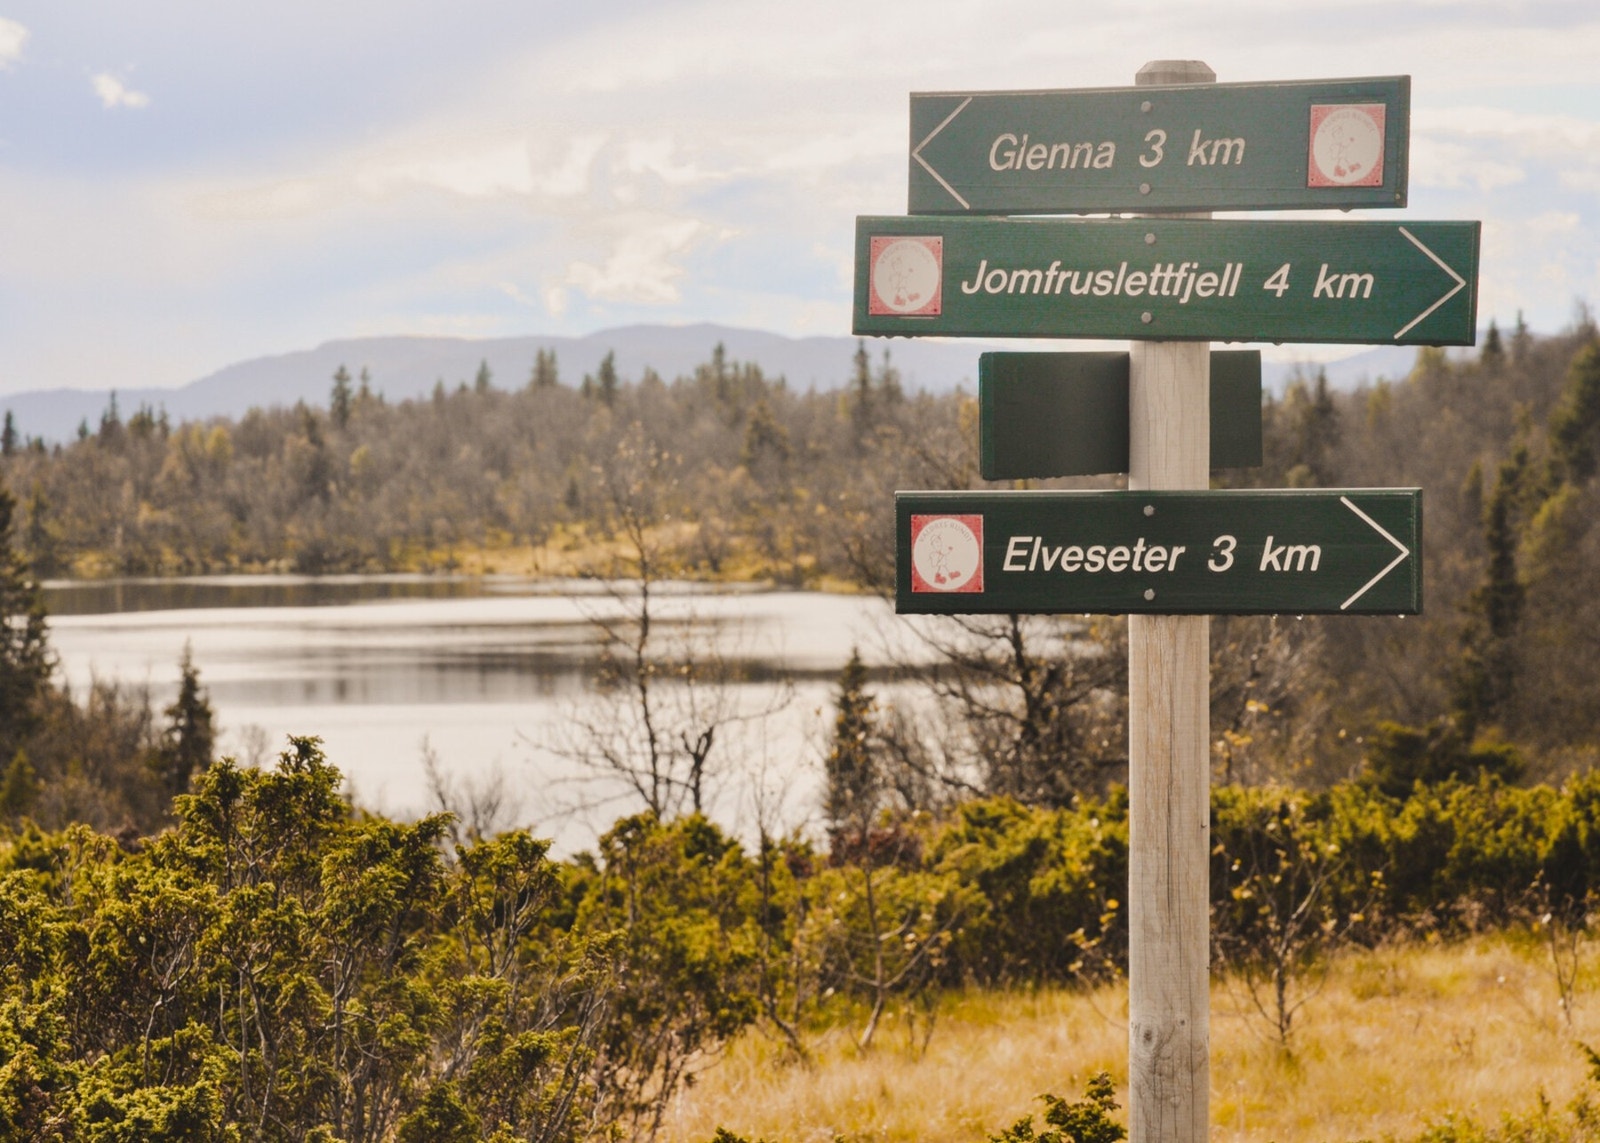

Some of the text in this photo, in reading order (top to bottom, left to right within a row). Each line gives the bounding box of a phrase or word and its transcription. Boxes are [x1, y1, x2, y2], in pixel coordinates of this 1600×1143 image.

[989, 129, 1246, 171] Glenna 3 km
[961, 259, 1375, 304] Jomfruslettfjell 4 km
[1002, 534, 1322, 573] Elveseter 3 km
